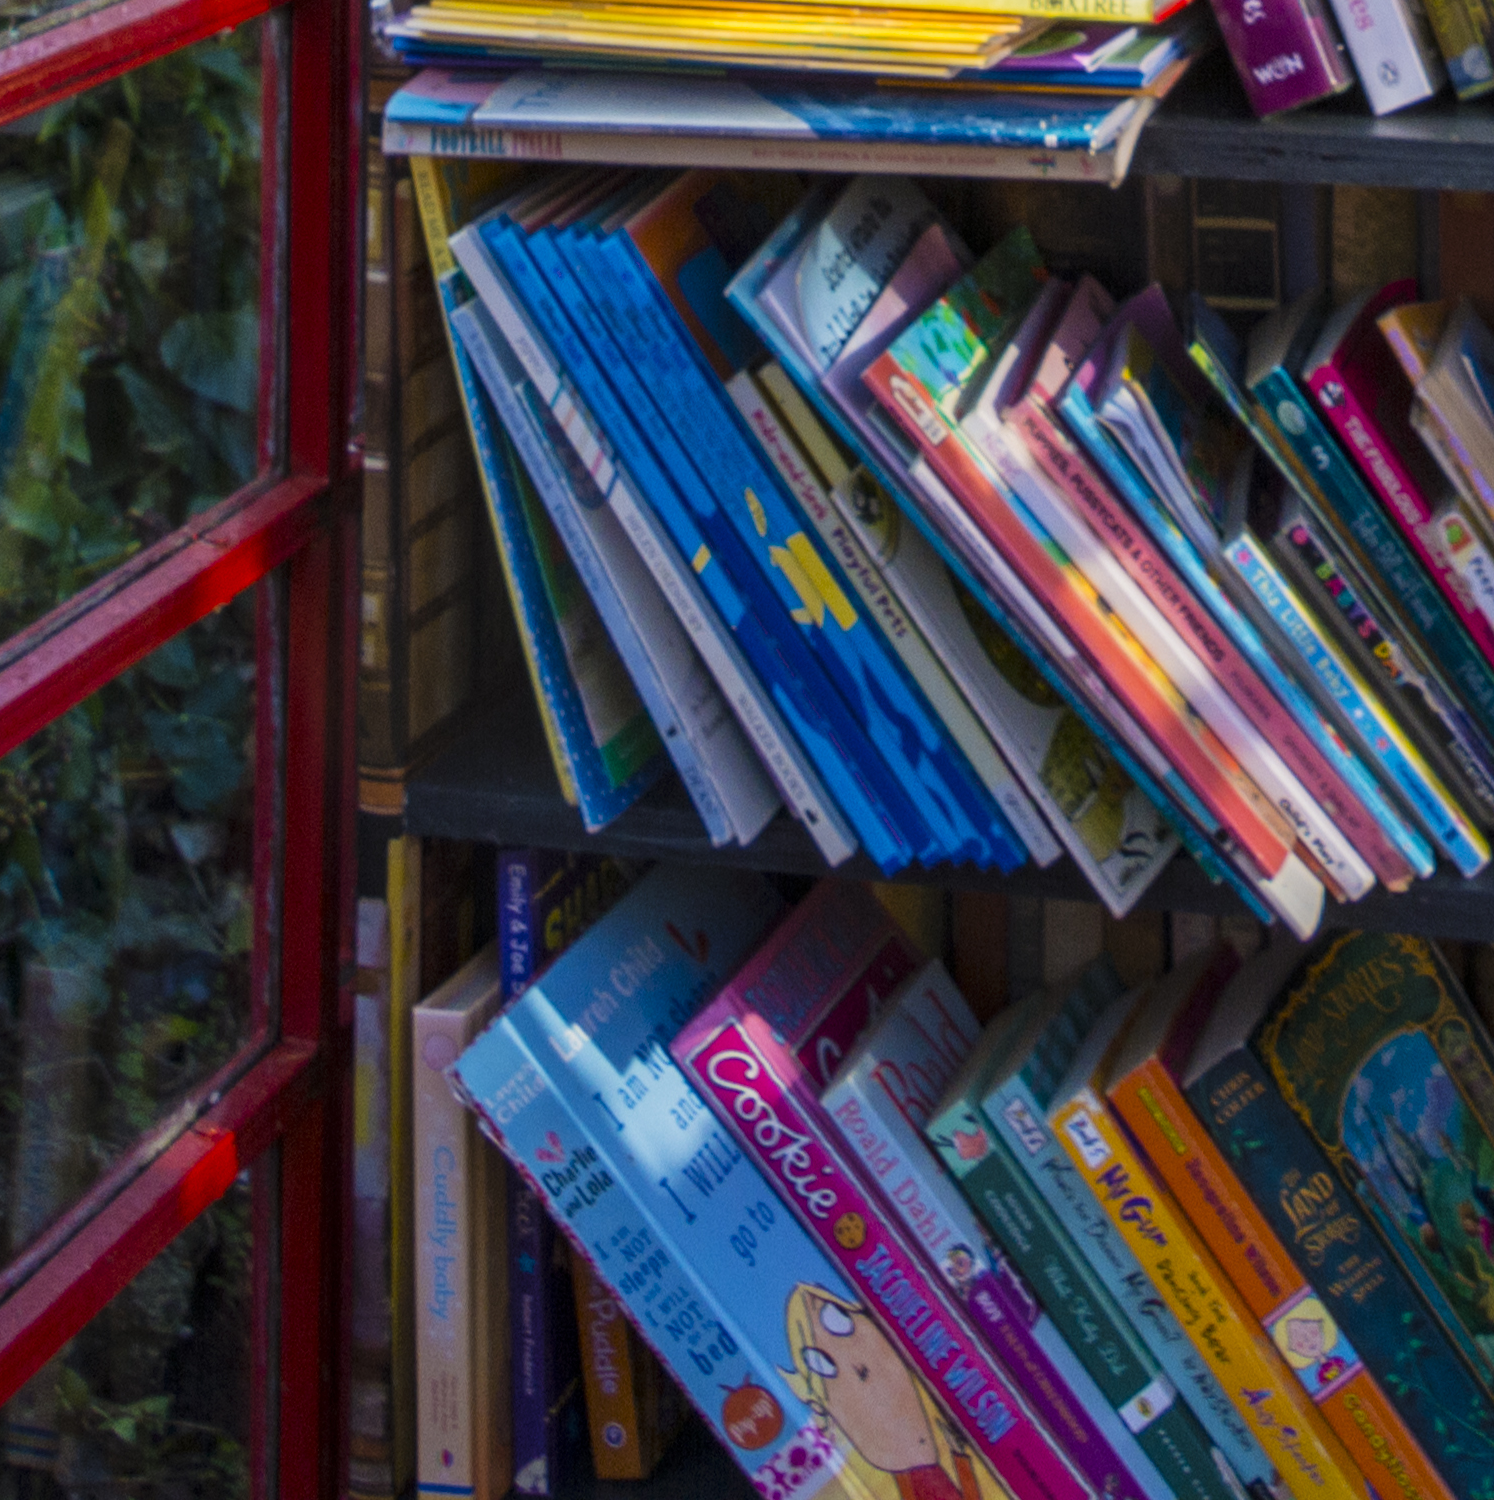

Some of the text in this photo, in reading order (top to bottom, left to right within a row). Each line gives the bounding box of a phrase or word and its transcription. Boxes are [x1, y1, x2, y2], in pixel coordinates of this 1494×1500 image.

[1064, 471, 1137, 551] PUSSYCATS
[1137, 556, 1184, 607] OTHER
[1173, 603, 1231, 665] FRIENDS
[1249, 567, 1284, 608] This
[1312, 655, 1353, 702] Baby
[503, 863, 530, 974] Emily & Joe
[541, 1146, 600, 1199] Charlie
[658, 1132, 744, 1225] I WILL
[693, 1037, 862, 1223] Cookie
[830, 1095, 954, 1251] Roald Dahl
[423, 1144, 460, 1249] Cuddly
[729, 1200, 776, 1267] go to
[1093, 1162, 1175, 1256] Mr Gum
[424, 1254, 459, 1323] baby
[1149, 1255, 1210, 1327] Dancing
[1198, 1322, 1238, 1367] Bear
[583, 1297, 632, 1398] Puddle
[847, 1240, 1023, 1446] JACQUELINE WILSON
